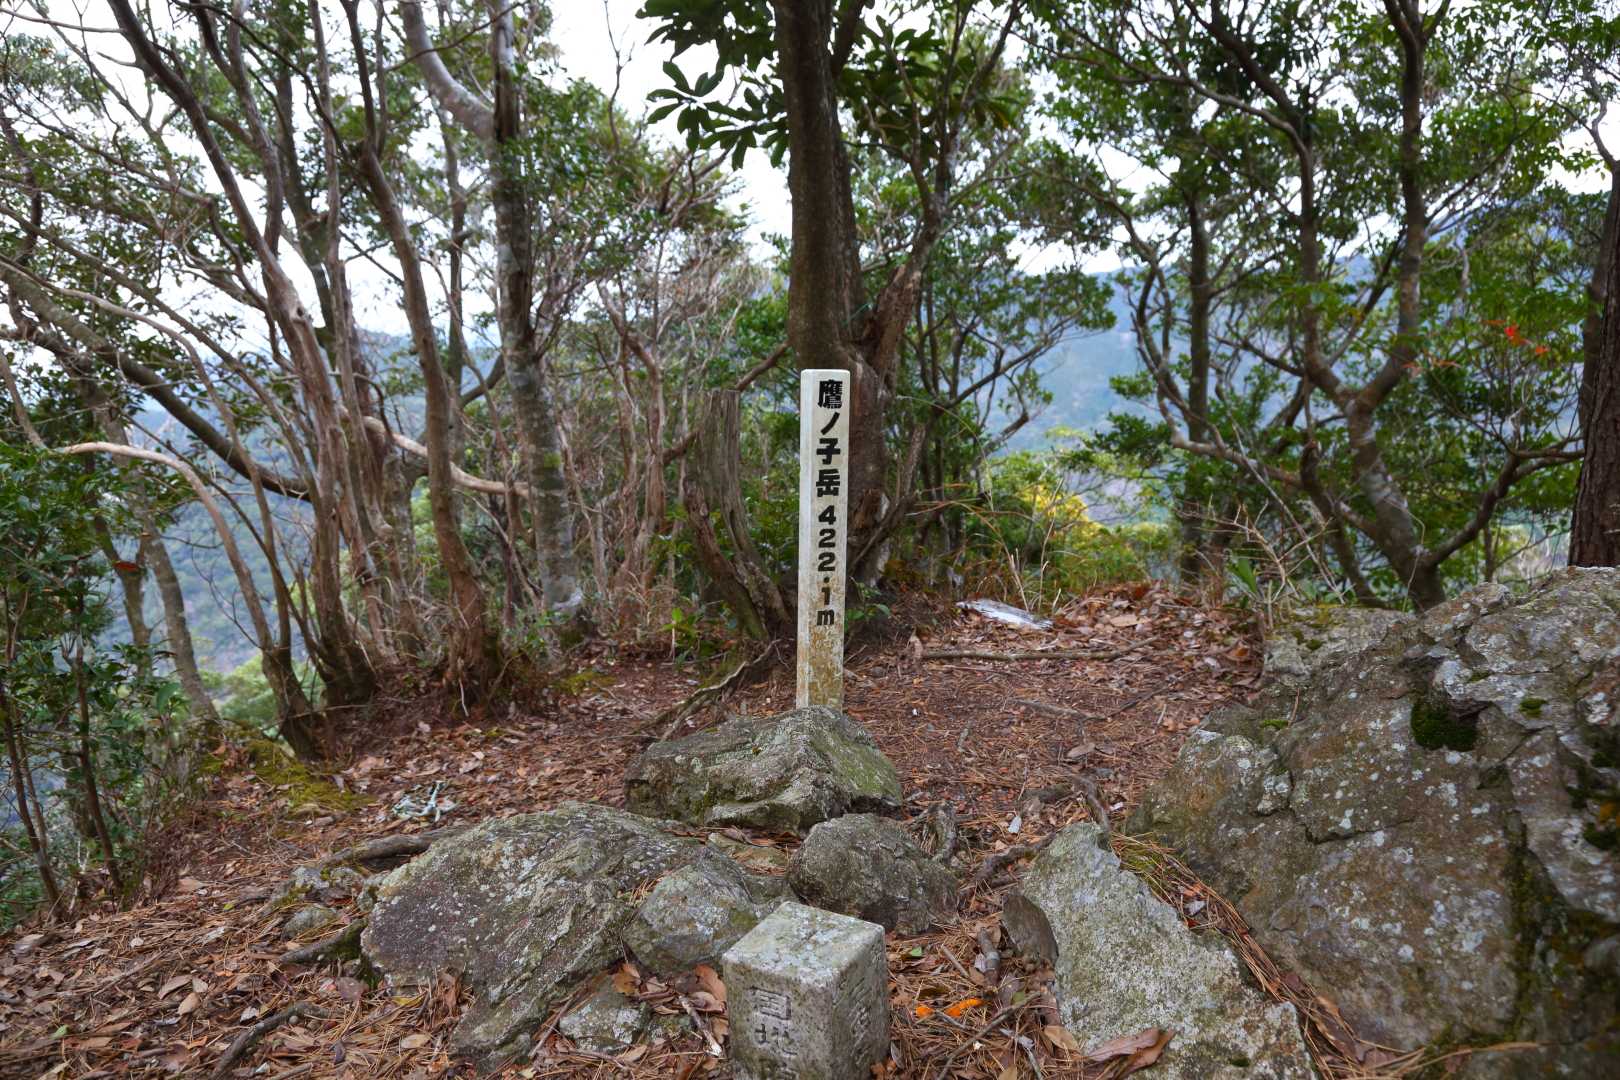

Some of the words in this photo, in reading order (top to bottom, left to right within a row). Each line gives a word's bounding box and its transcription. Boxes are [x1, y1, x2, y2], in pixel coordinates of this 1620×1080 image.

[816, 379, 843, 498] 鷹ノ子岳
[816, 505, 837, 626] 422.1m
